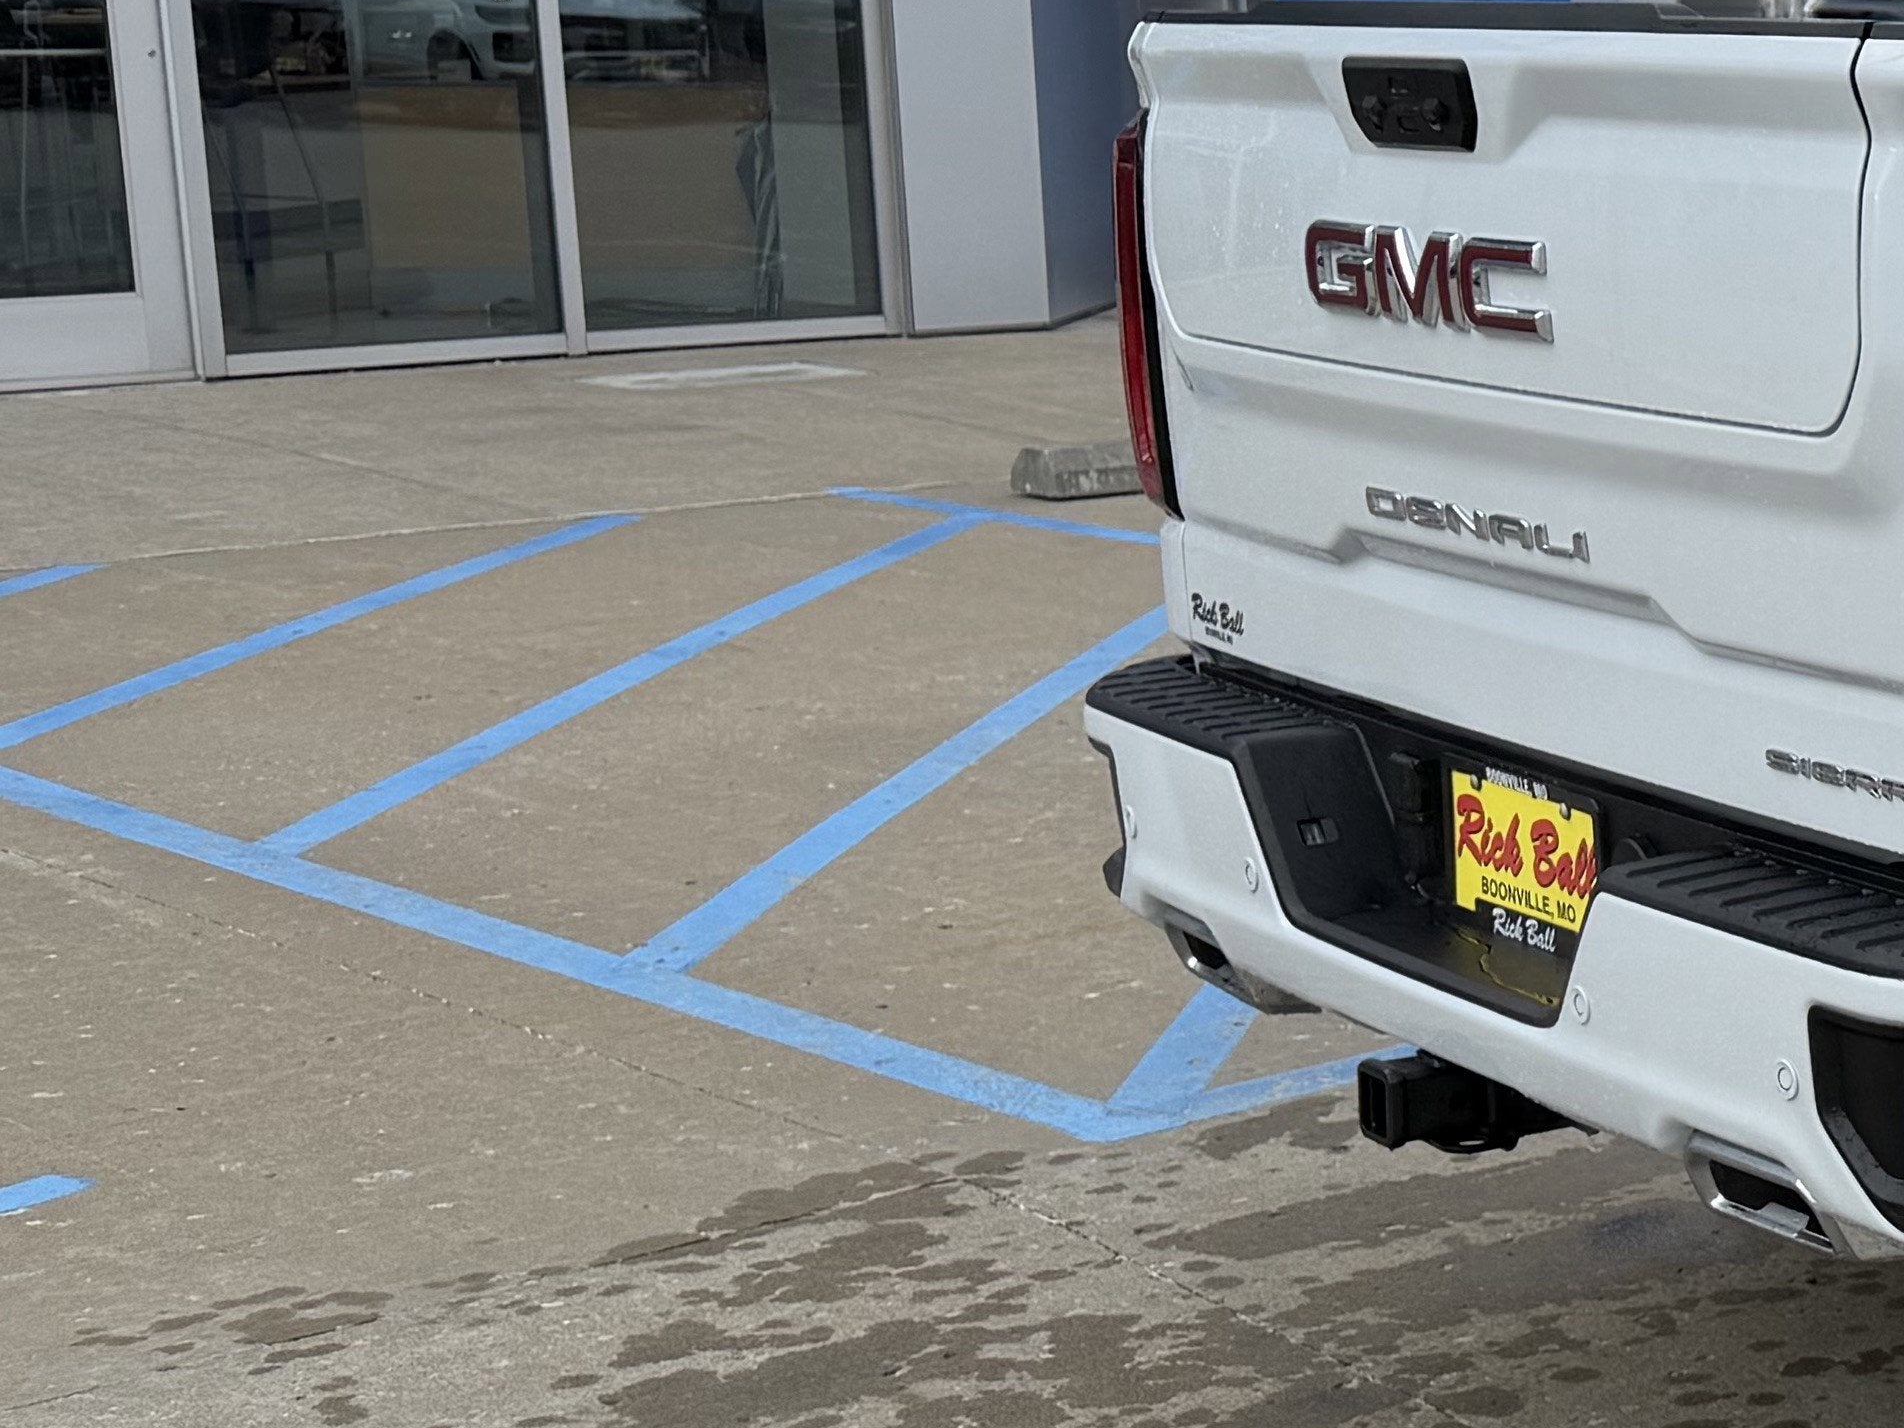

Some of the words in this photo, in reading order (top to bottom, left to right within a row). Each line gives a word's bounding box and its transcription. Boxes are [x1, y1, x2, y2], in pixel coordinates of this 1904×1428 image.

[1305, 219, 1554, 344] GMC
[1365, 486, 1591, 563] DENALI
[1191, 592, 1218, 627] Rick
[1219, 602, 1245, 636] Ball
[1456, 793, 1524, 878] Rick
[1530, 817, 1598, 900] Ball
[1481, 875, 1555, 920] BOONVILLE,
[1556, 899, 1577, 923] MO
[1492, 908, 1524, 942] Rick
[1525, 918, 1557, 953] Ball
